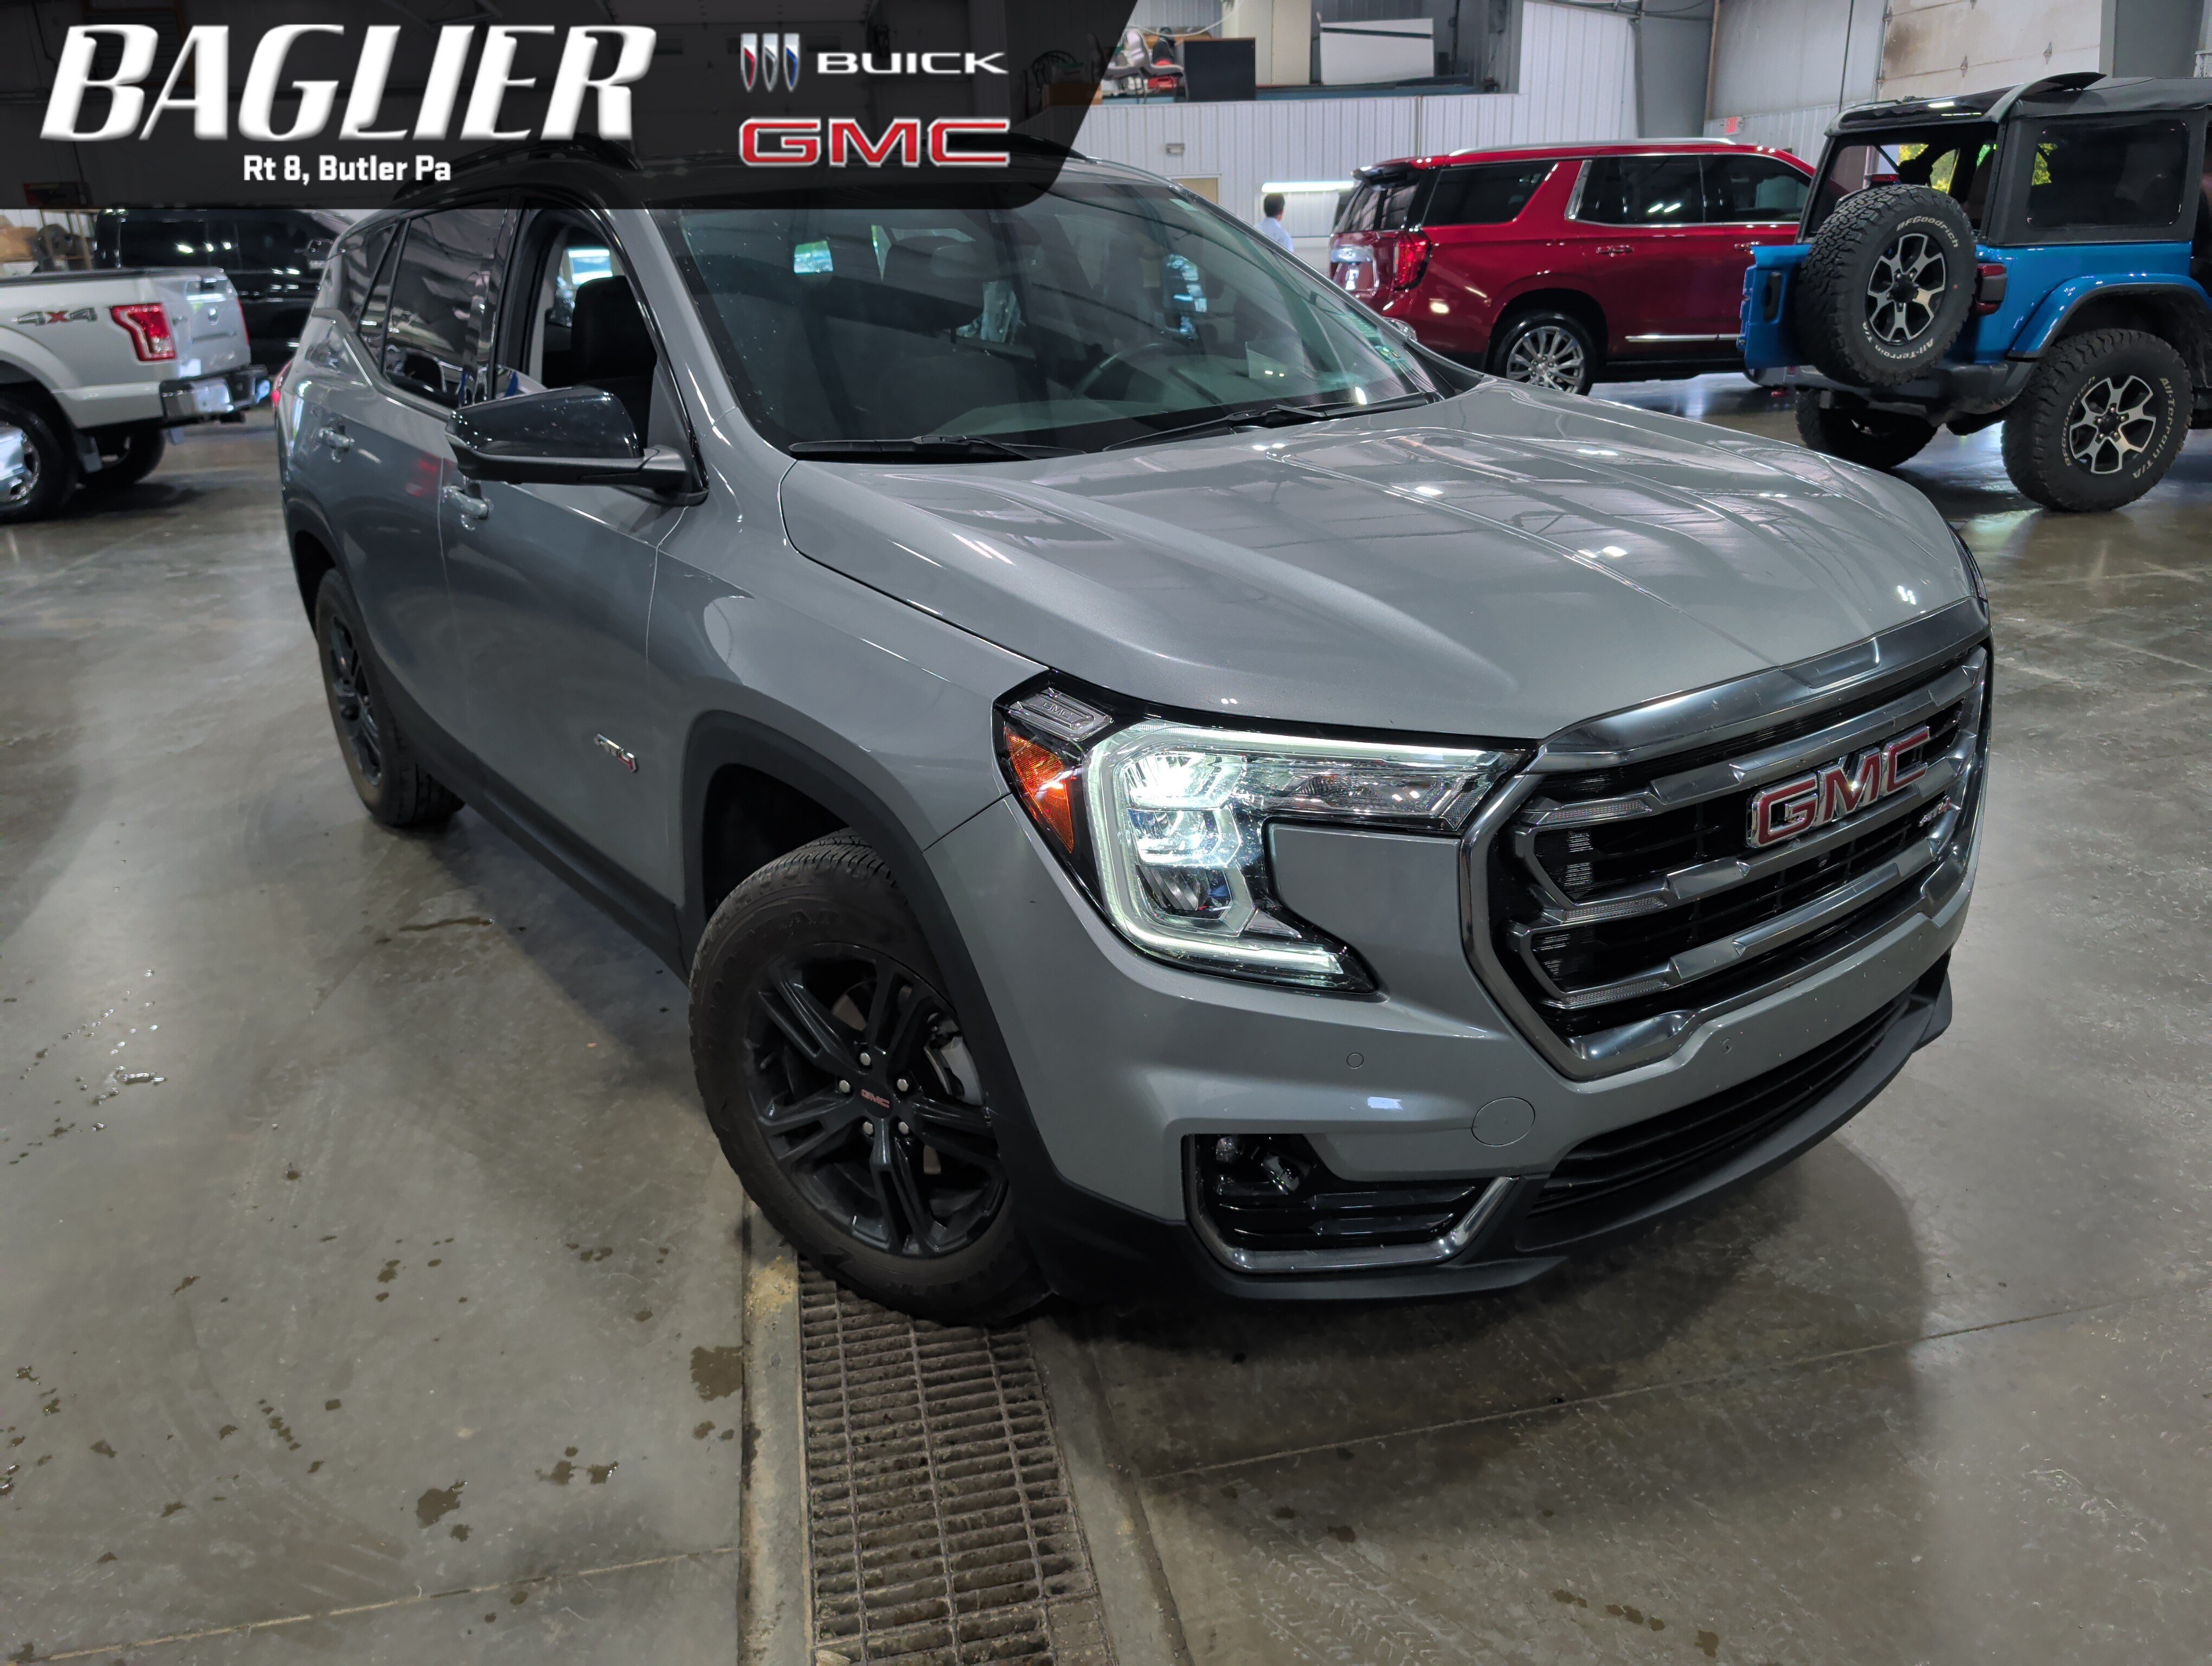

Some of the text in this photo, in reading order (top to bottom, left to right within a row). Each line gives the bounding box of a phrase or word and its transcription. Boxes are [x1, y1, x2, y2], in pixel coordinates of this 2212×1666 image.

[1896, 216, 1959, 248] BFGoodrich
[1875, 337, 1934, 359] All-Terrain
[2152, 378, 2176, 458] All-Terrain
[1746, 726, 1931, 848] GMC
[861, 1088, 890, 1109] GMC
